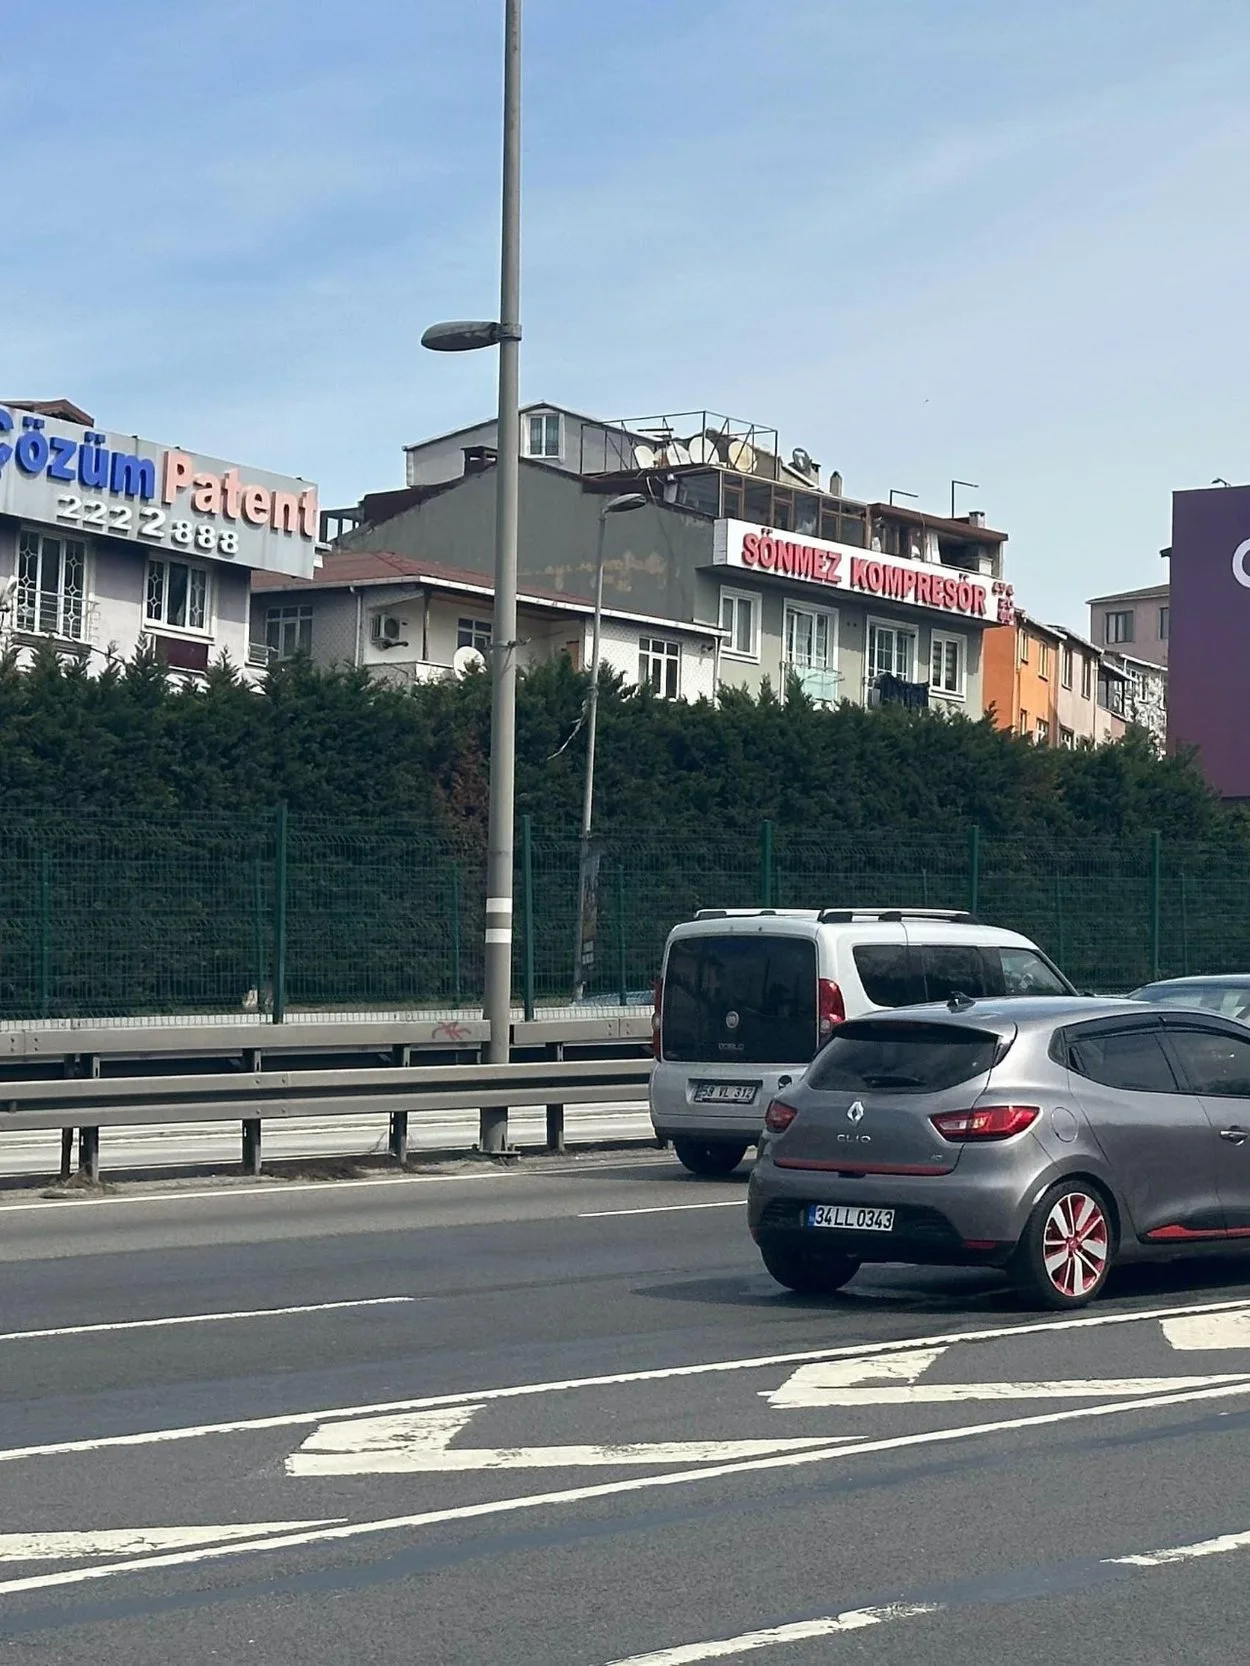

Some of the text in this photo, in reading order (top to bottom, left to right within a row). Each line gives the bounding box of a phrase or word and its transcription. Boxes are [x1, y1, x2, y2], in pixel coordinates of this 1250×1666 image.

[162, 450, 319, 538] Patent
[742, 527, 842, 585] SÖNMEZ
[851, 556, 986, 616] KOMPRESÖR
[837, 1134, 871, 1143] CLIO
